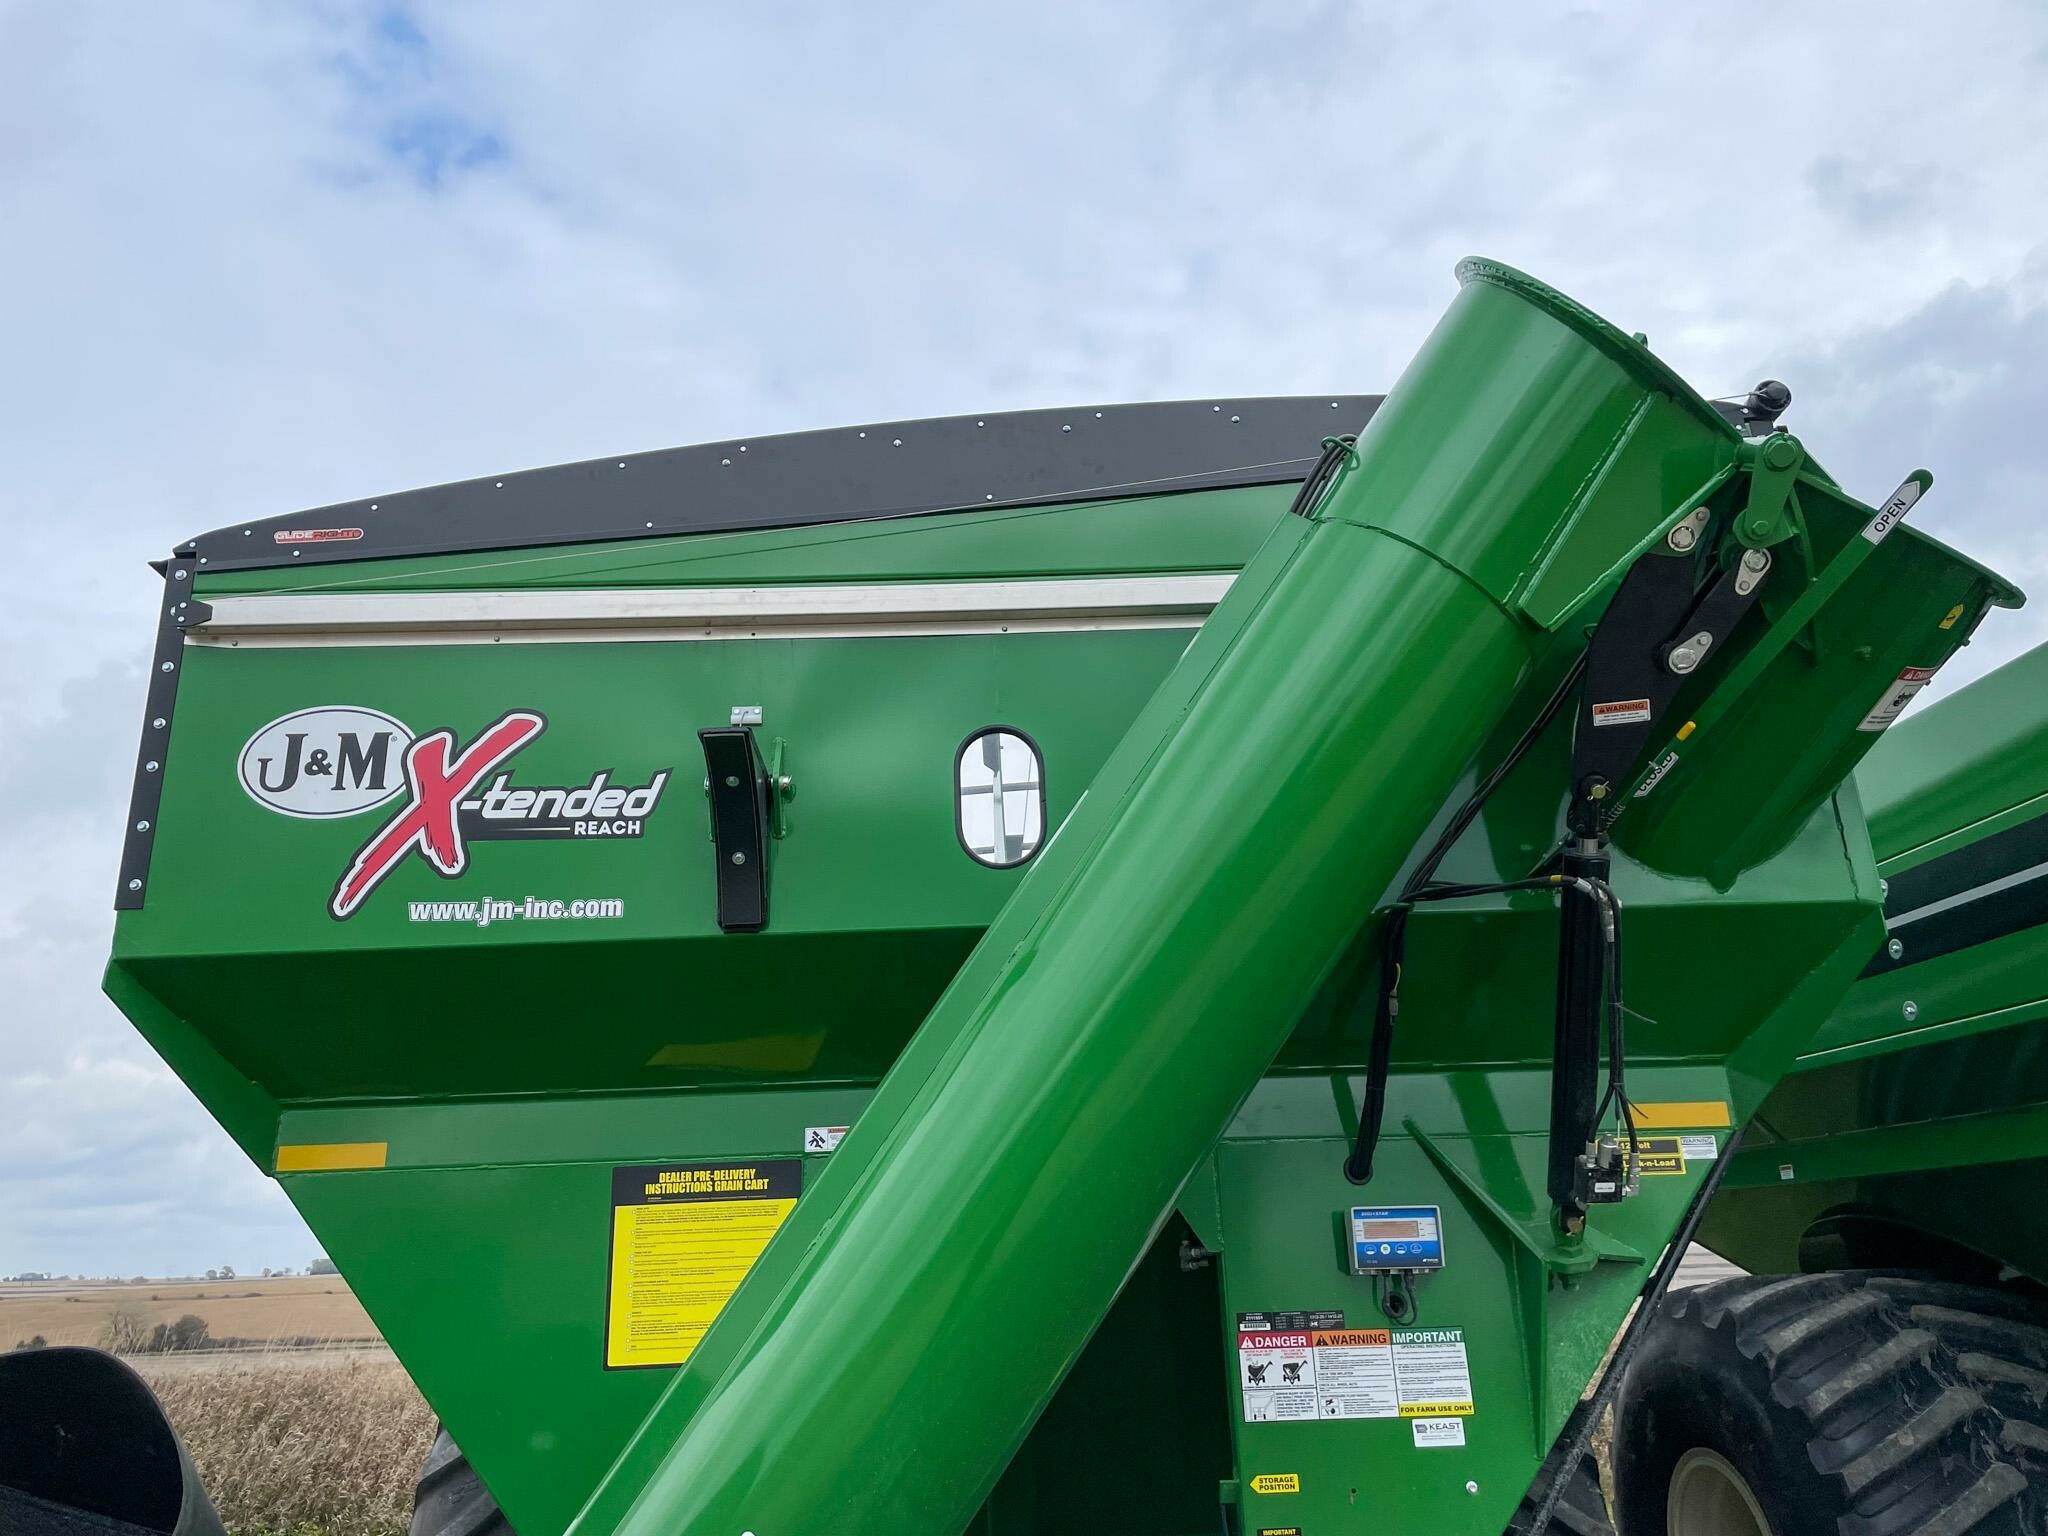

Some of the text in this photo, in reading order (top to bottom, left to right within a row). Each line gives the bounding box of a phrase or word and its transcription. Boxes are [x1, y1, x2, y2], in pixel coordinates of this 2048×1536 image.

[1874, 498, 1906, 532] OPEN
[1605, 702, 1645, 713] WARNING
[258, 731, 393, 793] J&M
[574, 821, 641, 835] REACH
[408, 897, 624, 927] www.jm-inc.com
[1622, 1158, 1676, 1168] Lk-n-Load
[659, 1168, 756, 1183] DEALER PRE-DELIVERY
[645, 1178, 769, 1195] INSTRUCTIONS GRAIN CART
[1255, 1336, 1307, 1347] DANGER
[1329, 1333, 1387, 1346] WARNING
[1392, 1330, 1462, 1343] IMPORTANT
[1429, 1422, 1461, 1431] KEAST
[1258, 1476, 1295, 1484] STORAGE
[1259, 1483, 1296, 1491] POSITION
[1262, 1528, 1297, 1536] IMPORTANT
